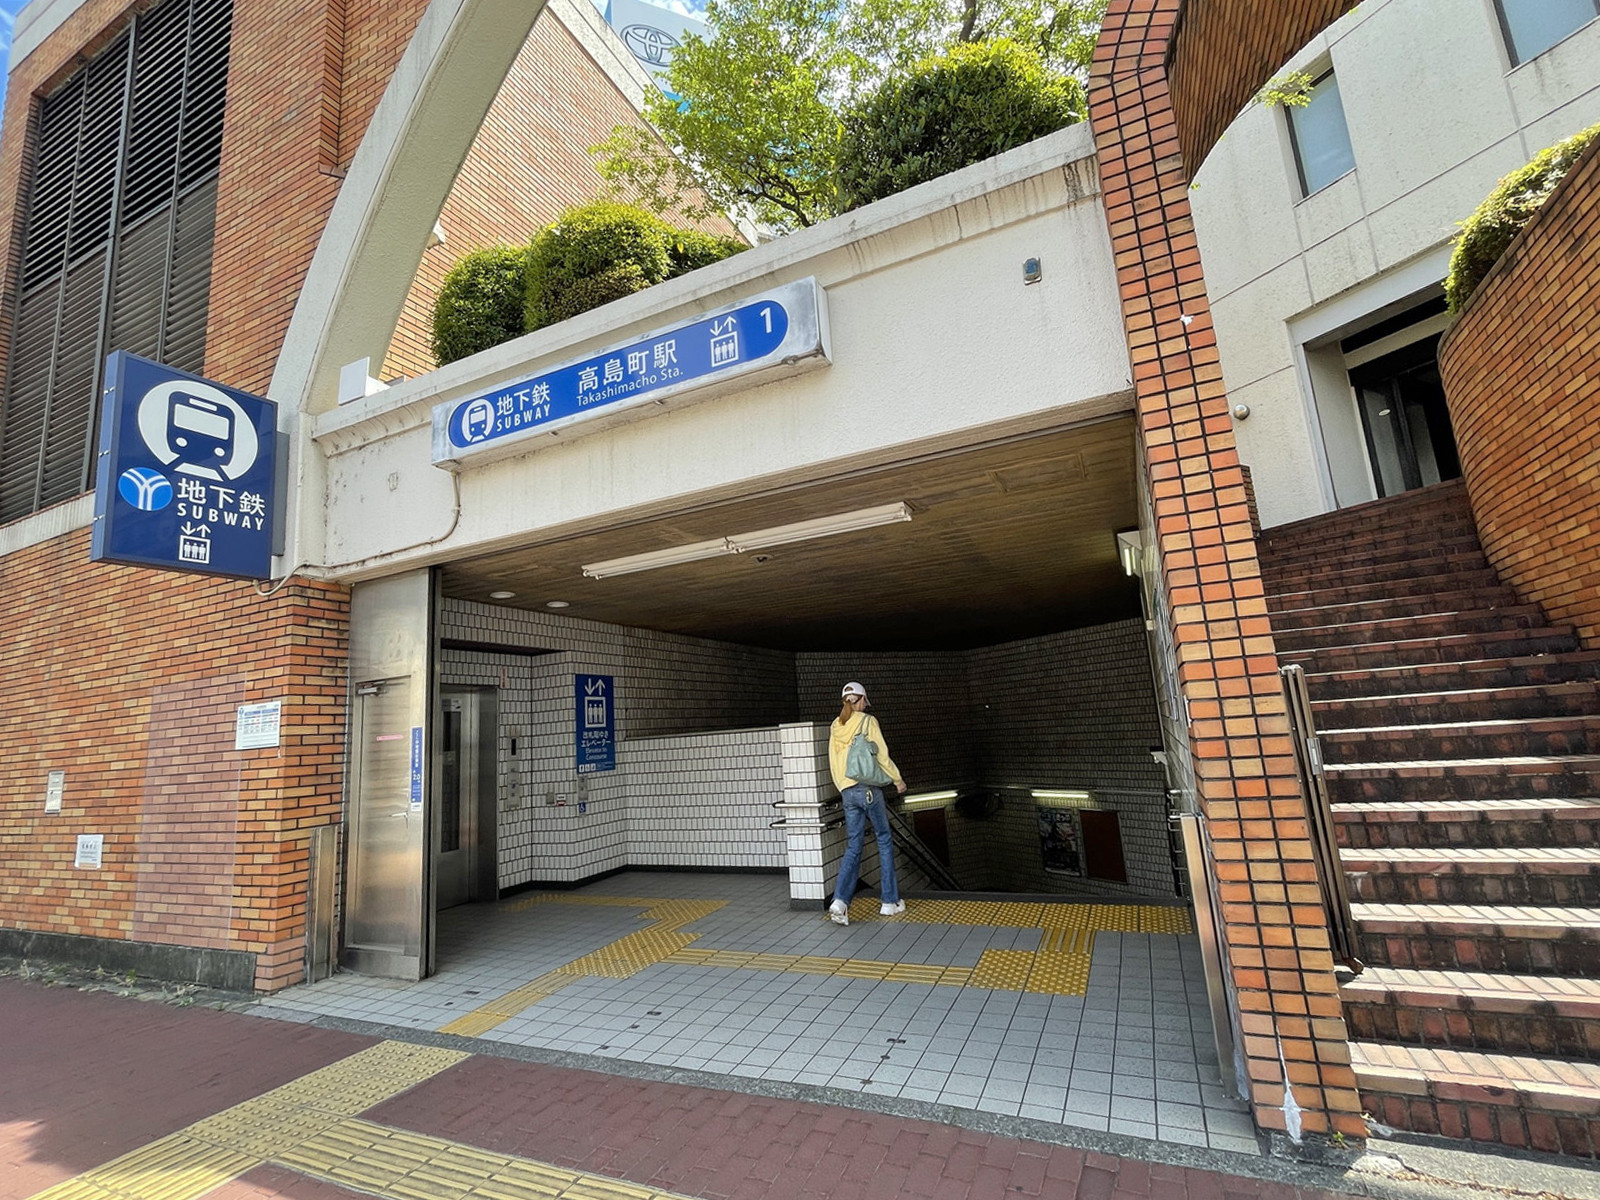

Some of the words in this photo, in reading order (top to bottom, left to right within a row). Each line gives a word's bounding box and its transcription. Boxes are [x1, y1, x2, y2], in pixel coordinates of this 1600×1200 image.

[760, 307, 773, 334] 1
[578, 339, 678, 394] 高島町駅
[496, 381, 551, 416] 地下鉄
[576, 371, 657, 407] Takashimacho
[660, 366, 684, 381] Sta.
[496, 404, 551, 432] SUBWAY
[177, 477, 266, 517] 地下鉄
[177, 503, 265, 531] SUBWAY
[581, 739, 611, 747] エレベーター
